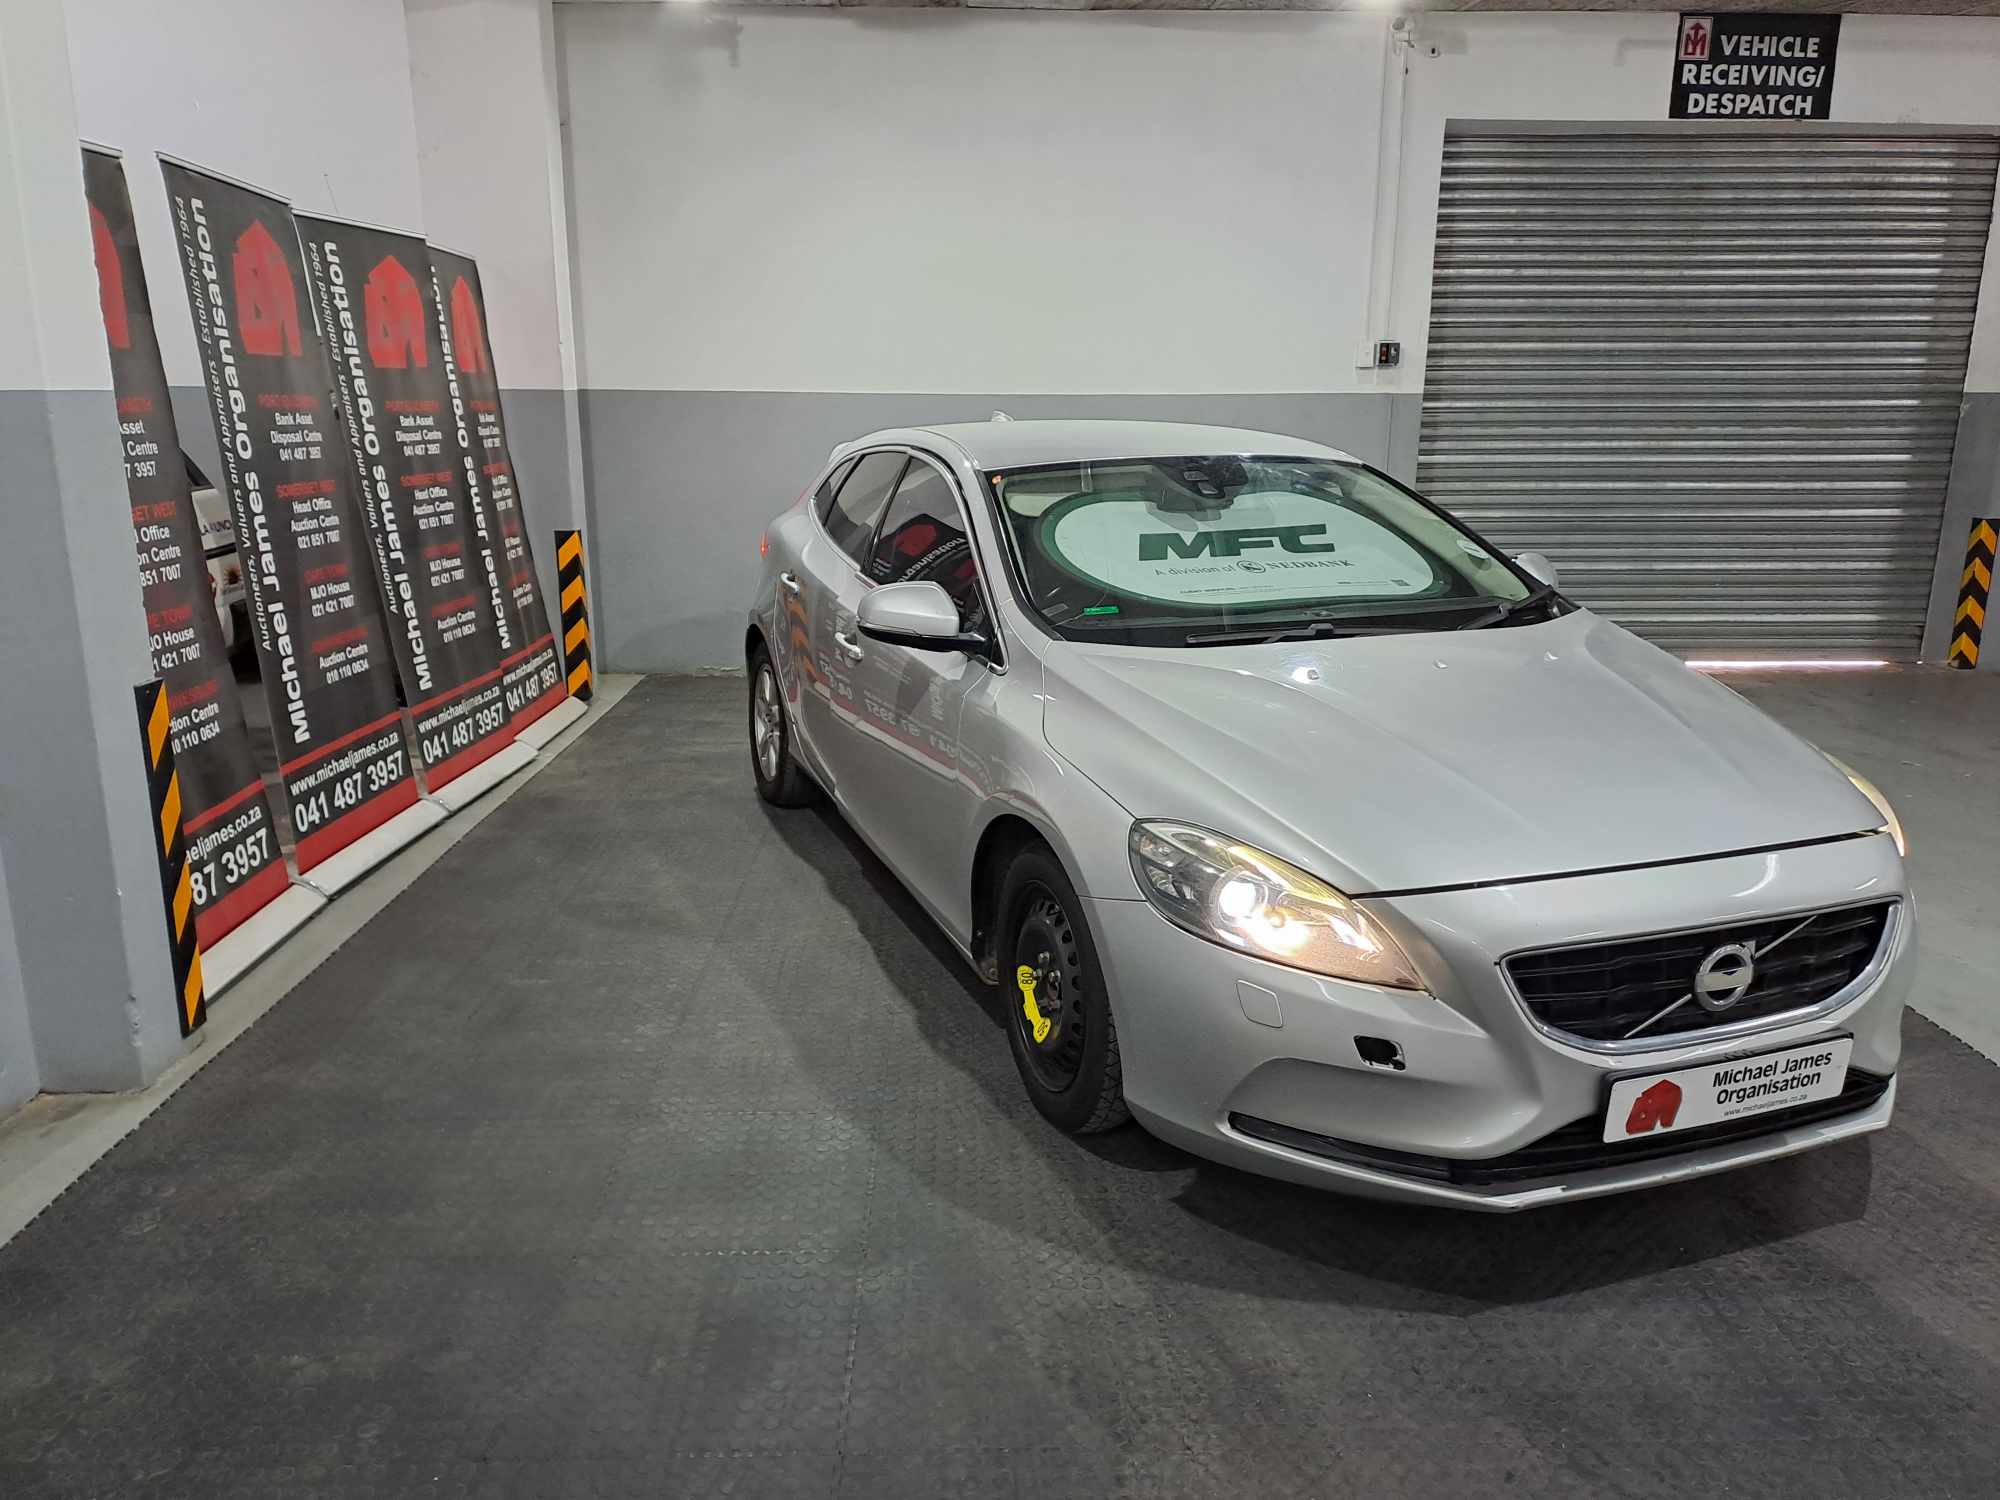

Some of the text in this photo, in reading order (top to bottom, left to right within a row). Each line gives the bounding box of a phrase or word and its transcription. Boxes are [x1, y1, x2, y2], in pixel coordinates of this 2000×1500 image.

[1720, 34, 1820, 58] VEHICLE
[1681, 63, 1826, 88] RECEIVING/
[1687, 93, 1813, 116] DESPATCH
[175, 196, 191, 240] 1964
[309, 242, 323, 277] 1964
[184, 244, 212, 344] Established
[316, 280, 342, 361] Established
[208, 360, 232, 448] Appraisers
[338, 374, 360, 447] Appraisers
[127, 441, 159, 457] Centre
[324, 241, 433, 691] Michael James Organisation
[352, 449, 367, 476] and
[134, 461, 157, 478] 3957
[191, 198, 311, 744] Michael James Organisation
[224, 451, 239, 484] and
[362, 480, 378, 529] Valuers
[464, 456, 489, 541] James
[140, 525, 171, 542] Office
[233, 488, 251, 548] Valuers
[290, 518, 319, 532] Auction
[150, 544, 181, 562] Centre
[1138, 523, 1336, 561] MFC
[159, 564, 181, 582] 7007
[1154, 567, 1165, 576] A
[1167, 564, 1220, 576] division
[1266, 558, 1354, 571] NEDBANK
[247, 555, 271, 651] Auctioneers,
[326, 581, 351, 595] House
[481, 548, 511, 650] Michael
[163, 627, 195, 647] House
[161, 651, 179, 669] 421
[180, 643, 200, 663] 7007
[319, 651, 346, 669] Auction
[506, 662, 558, 712] 041 487 3957
[191, 702, 219, 723] Centre
[417, 685, 500, 734] www.michaeljames.co.za
[182, 730, 199, 750] 110
[199, 720, 221, 742] 0634
[422, 702, 504, 764] 041 487 3957
[290, 731, 399, 796] www.michaeljames.co.za
[294, 750, 404, 832] 041 487 3957
[221, 827, 268, 883] 3957
[1712, 1052, 1832, 1087] Michael James
[1716, 1071, 1821, 1104] Organisation
